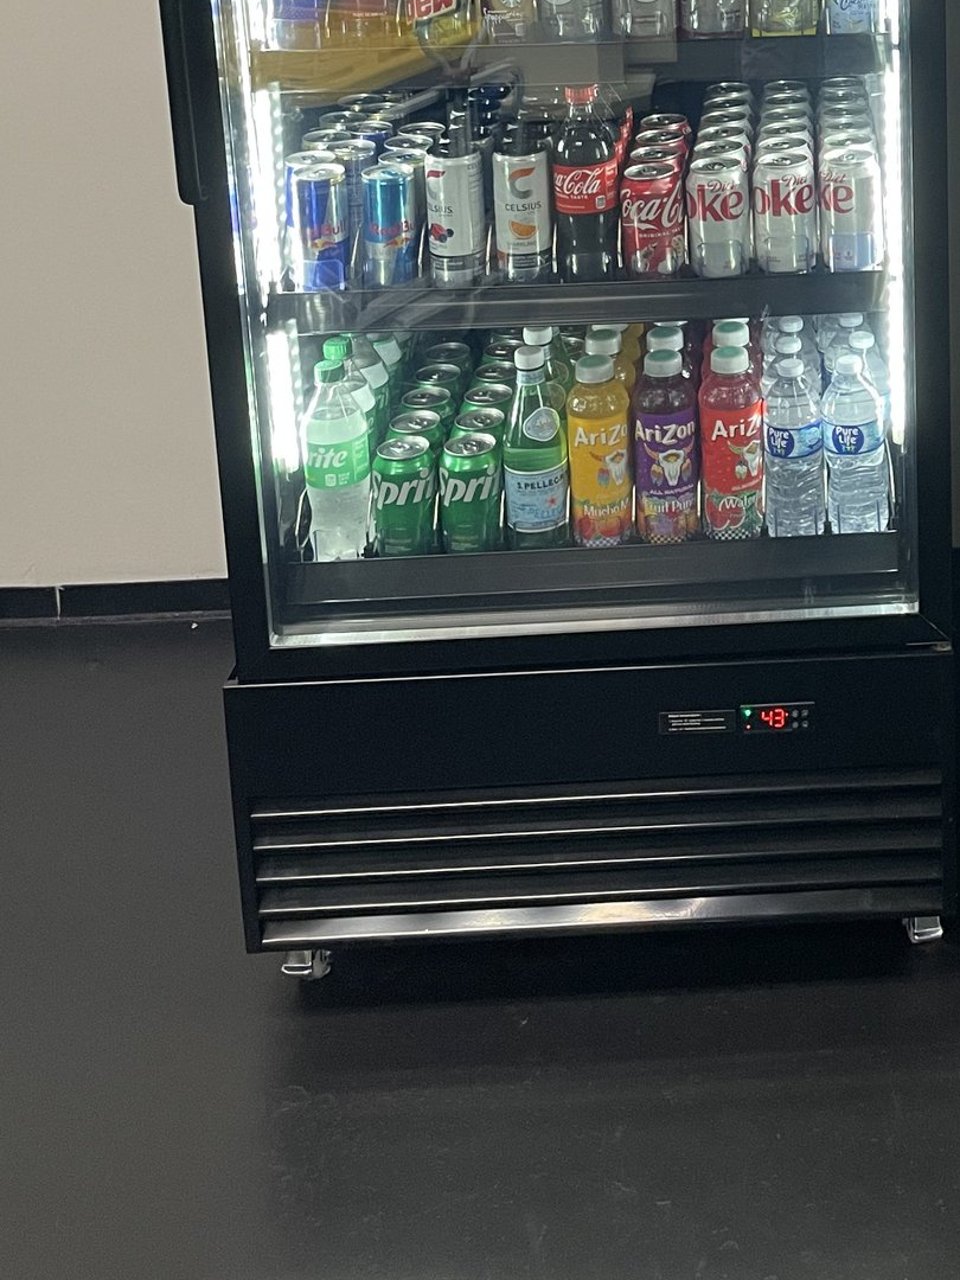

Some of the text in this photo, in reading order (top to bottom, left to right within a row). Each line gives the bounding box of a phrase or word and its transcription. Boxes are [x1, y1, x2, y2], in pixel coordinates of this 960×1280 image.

[504, 200, 542, 212] CELSIUS
[768, 428, 789, 440] Pure
[835, 425, 859, 437] Pure
[838, 434, 858, 447] Life
[761, 708, 784, 727] 43
